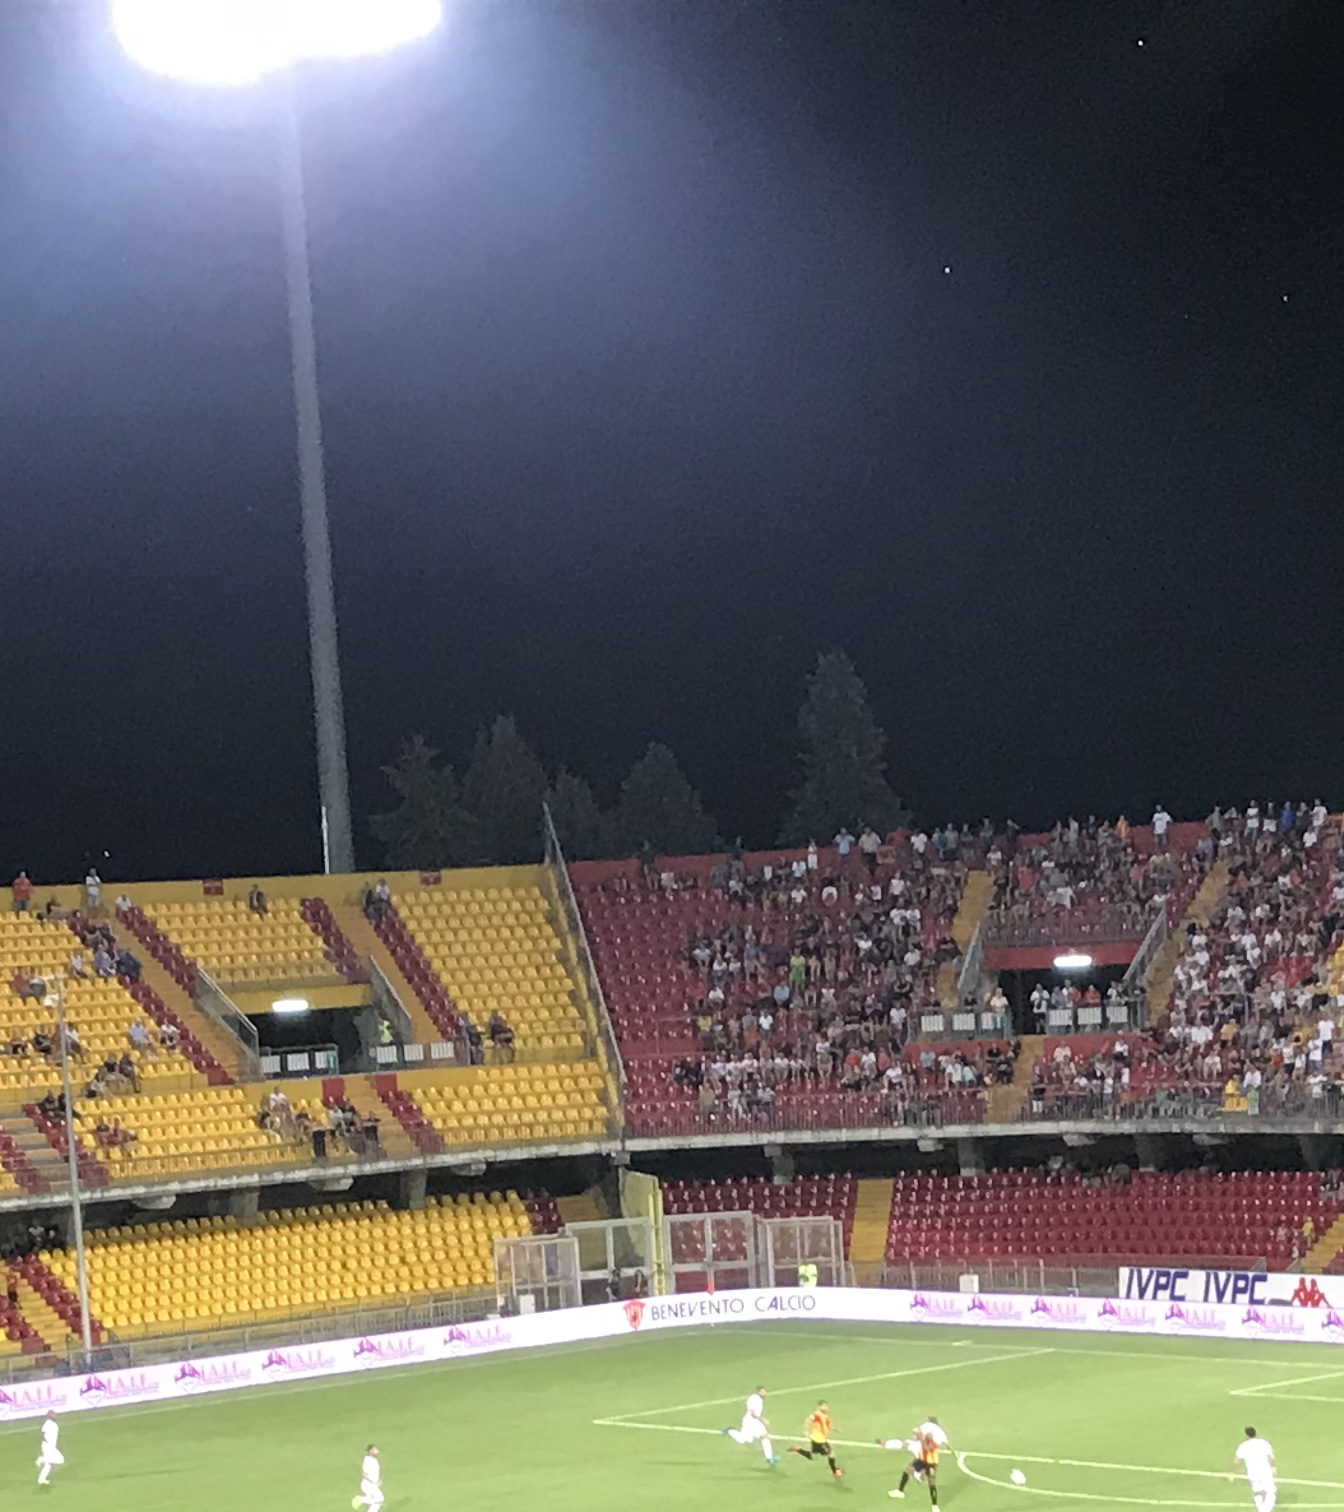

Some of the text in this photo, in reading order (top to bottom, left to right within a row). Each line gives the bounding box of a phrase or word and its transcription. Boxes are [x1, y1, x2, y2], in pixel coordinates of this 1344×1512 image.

[1125, 1268, 1268, 1305] IVPC IVPC
[651, 1294, 816, 1321] BENEVENTO CALCIO
